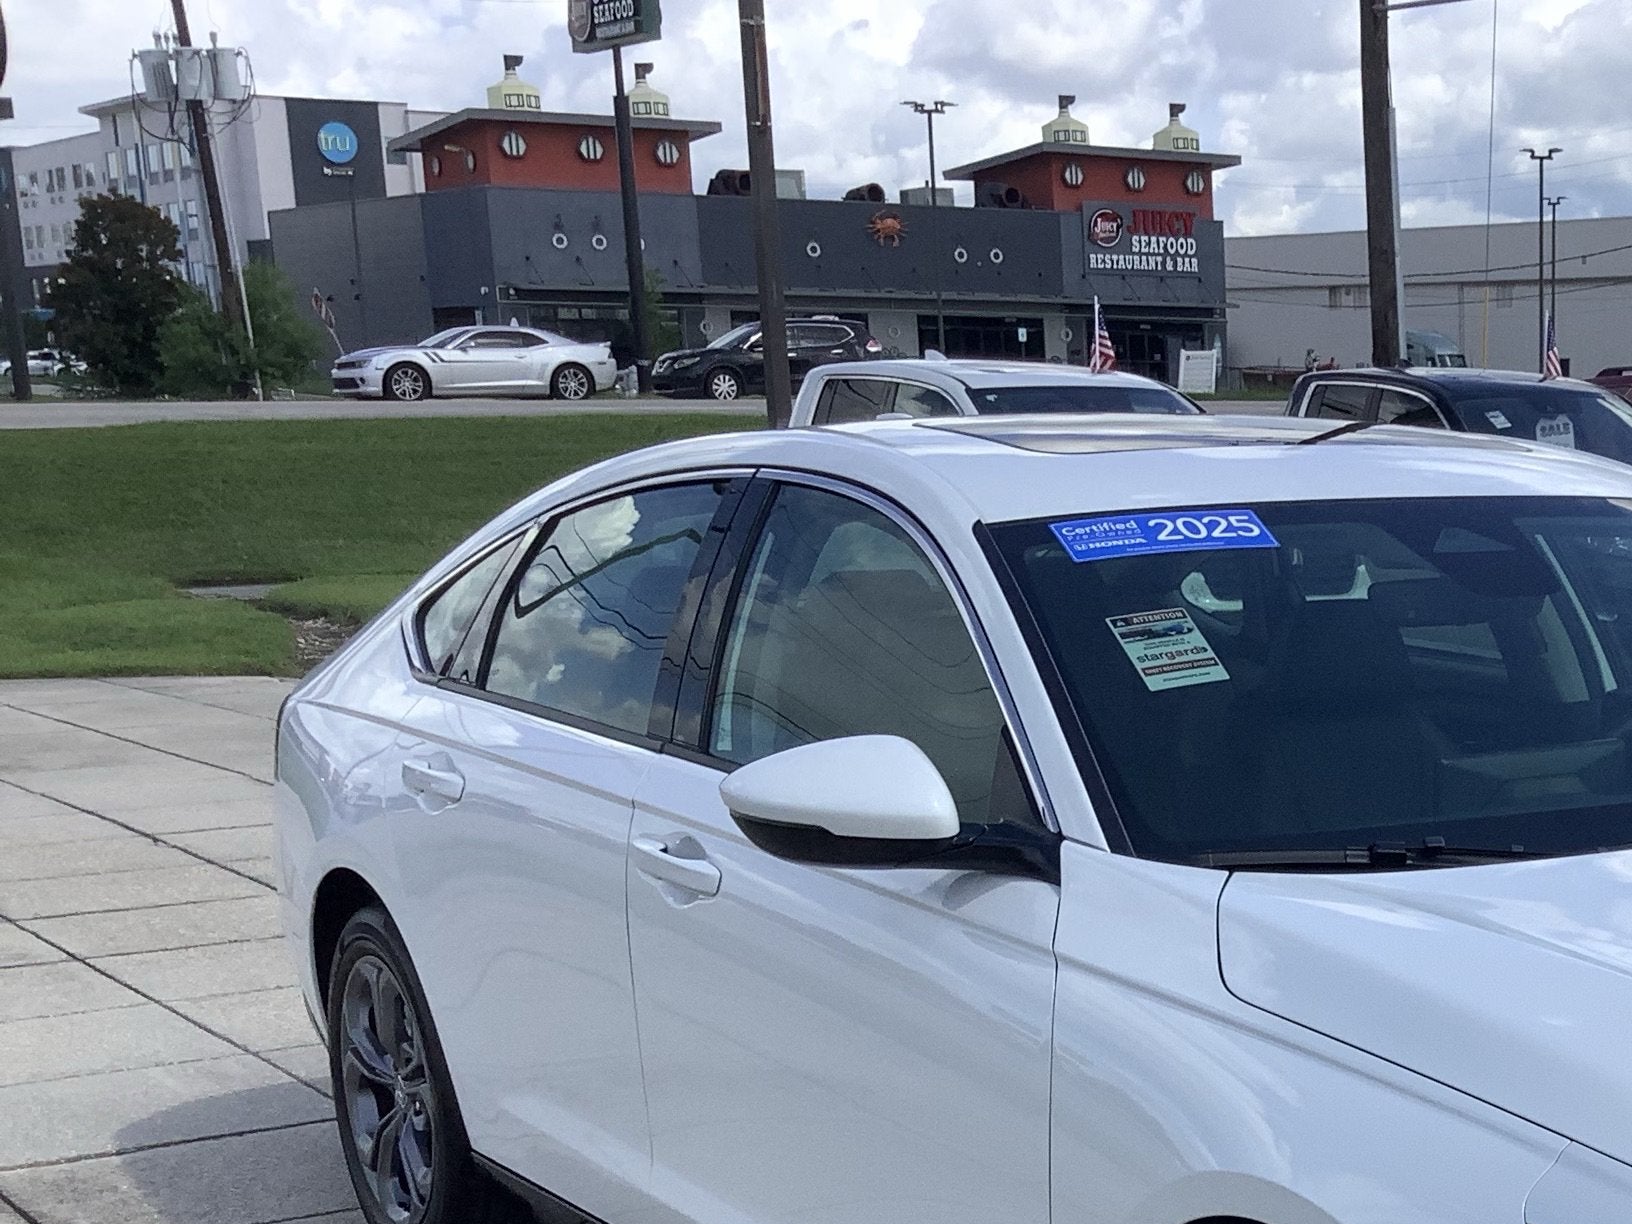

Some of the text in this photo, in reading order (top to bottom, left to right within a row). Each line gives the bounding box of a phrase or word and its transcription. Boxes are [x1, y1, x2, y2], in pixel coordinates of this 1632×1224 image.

[593, 0, 634, 24] SEAFOOD
[320, 131, 350, 152] tru
[1126, 208, 1197, 237] JUICY
[1131, 235, 1197, 255] SEAFOOD
[1089, 253, 1199, 273] RESTAURANT & BAR
[1061, 515, 1262, 542] Certified 2025
[1087, 537, 1149, 550] HONDA
[1132, 611, 1184, 624] ATTENTION
